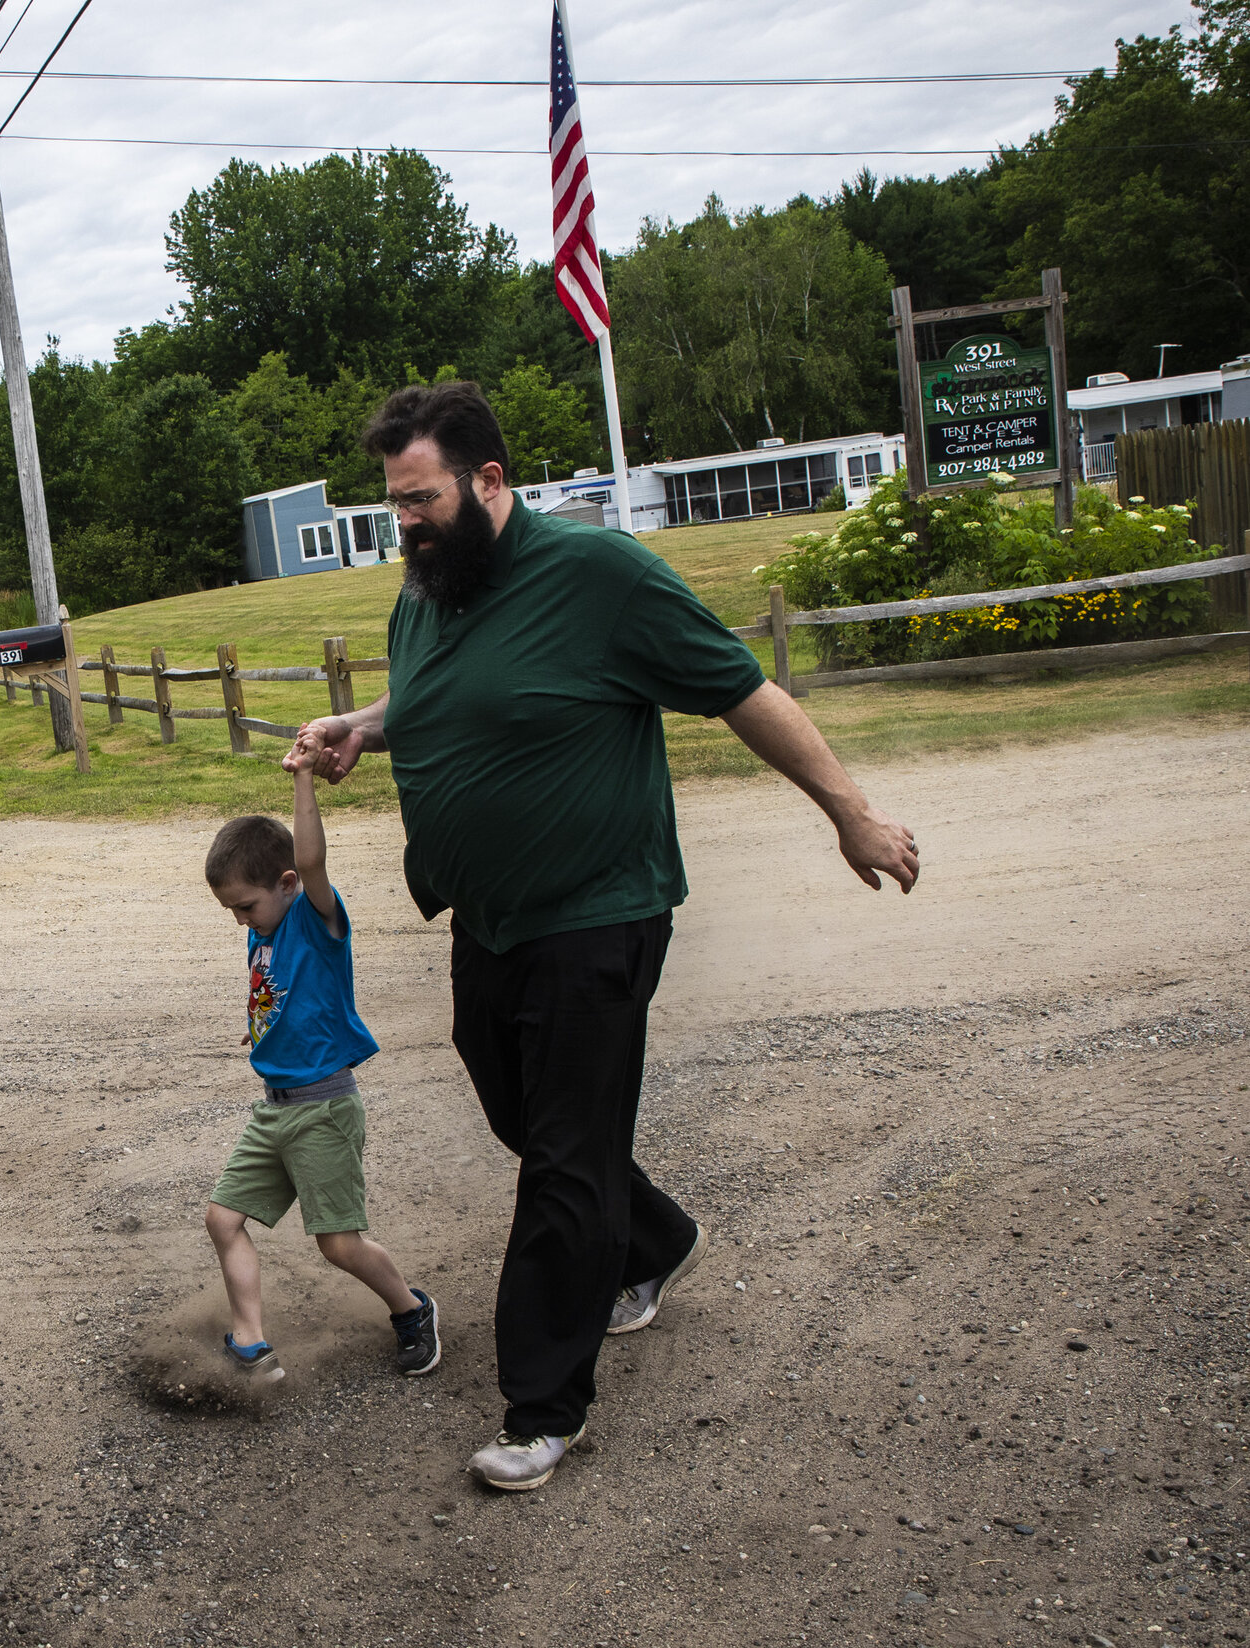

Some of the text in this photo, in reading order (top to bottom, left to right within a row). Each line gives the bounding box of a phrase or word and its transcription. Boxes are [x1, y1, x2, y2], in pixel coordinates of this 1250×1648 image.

[965, 342, 1003, 363] 391
[954, 358, 1016, 374] West street
[935, 395, 1047, 416] RV CAMPING
[962, 386, 1043, 405] Park & Family
[942, 416, 1037, 438] TENT & CAMPER
[958, 428, 1021, 443] SITES
[945, 435, 1035, 456] Camper Rentals
[938, 451, 1045, 477] 207-284-4282
[2, 650, 22, 663] 391
